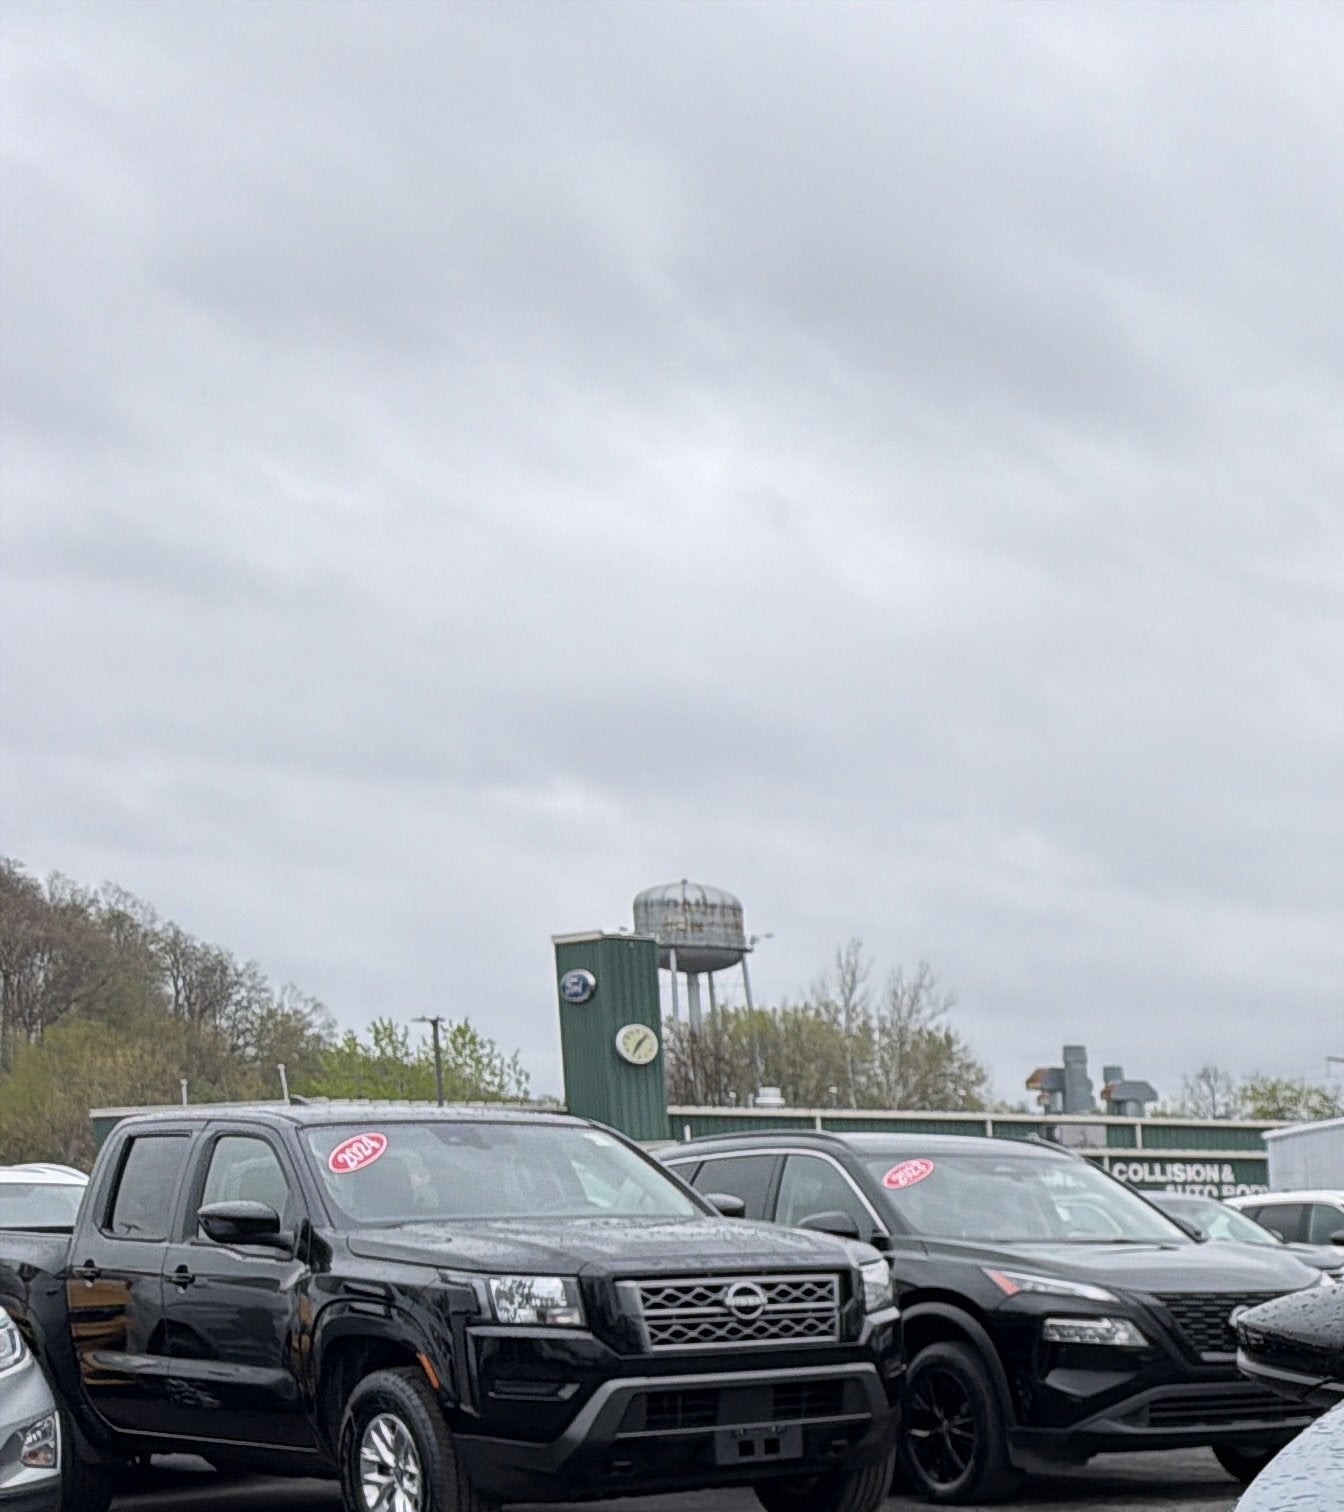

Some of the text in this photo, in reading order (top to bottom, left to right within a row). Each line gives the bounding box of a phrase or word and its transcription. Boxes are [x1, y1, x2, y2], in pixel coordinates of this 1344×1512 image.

[337, 1135, 381, 1169] 2024
[1112, 1162, 1235, 1183] COLLISION &
